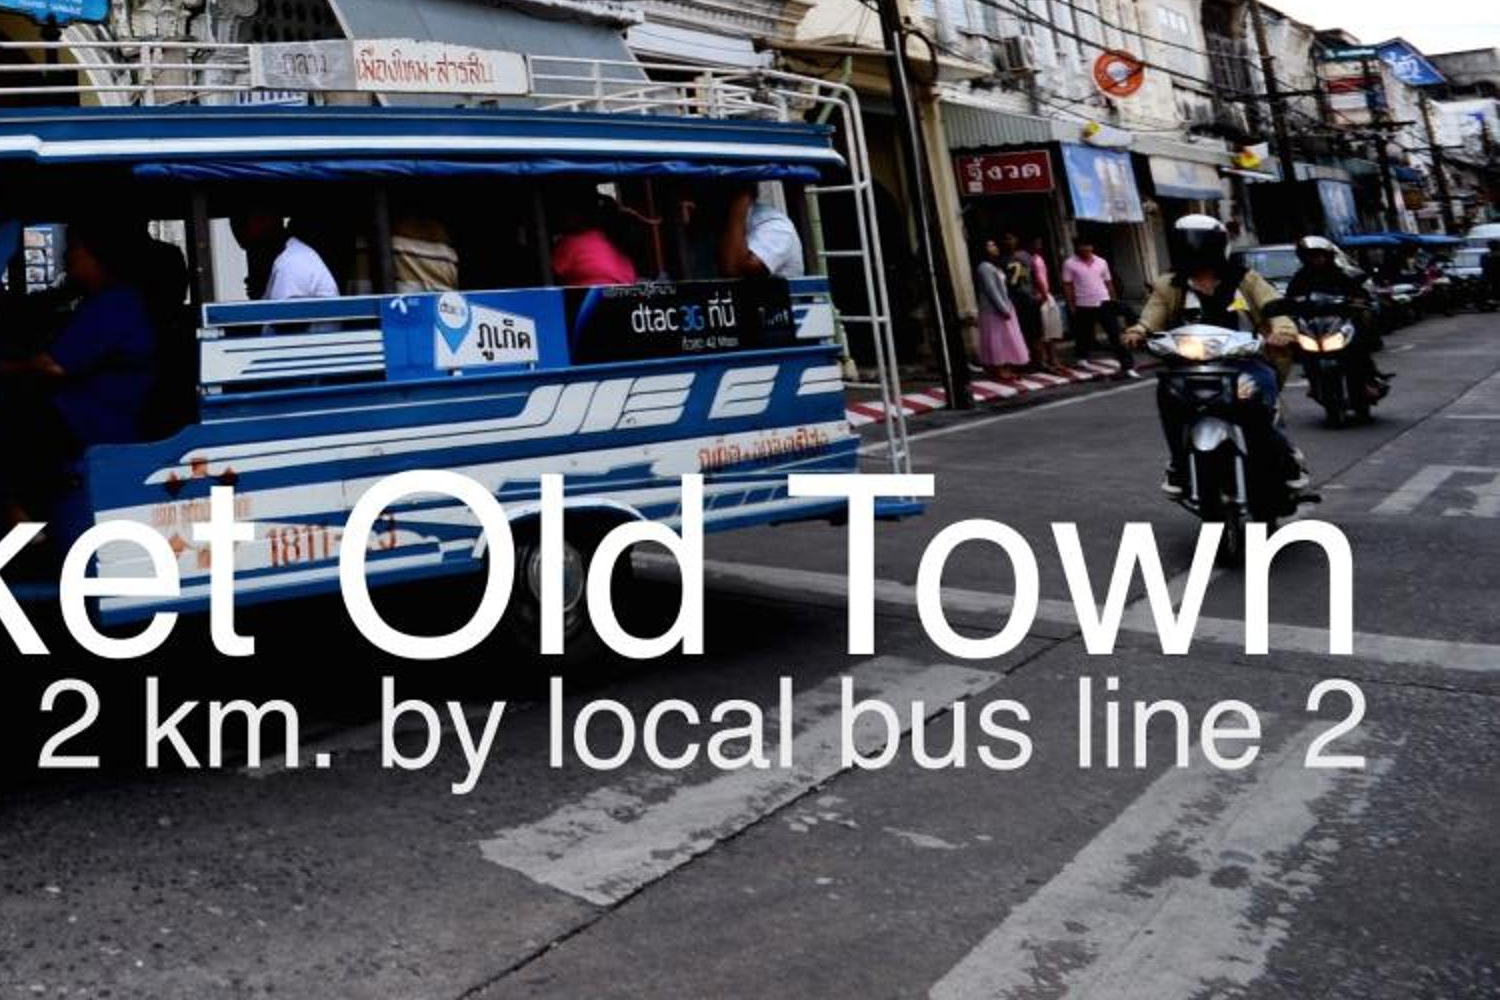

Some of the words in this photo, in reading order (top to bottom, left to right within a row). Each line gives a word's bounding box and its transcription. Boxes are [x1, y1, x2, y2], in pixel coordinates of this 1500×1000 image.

[630, 303, 679, 334] dtac
[679, 304, 706, 333] 3G
[707, 291, 737, 328] ที่นี่
[477, 318, 532, 361] ภูเก็ต
